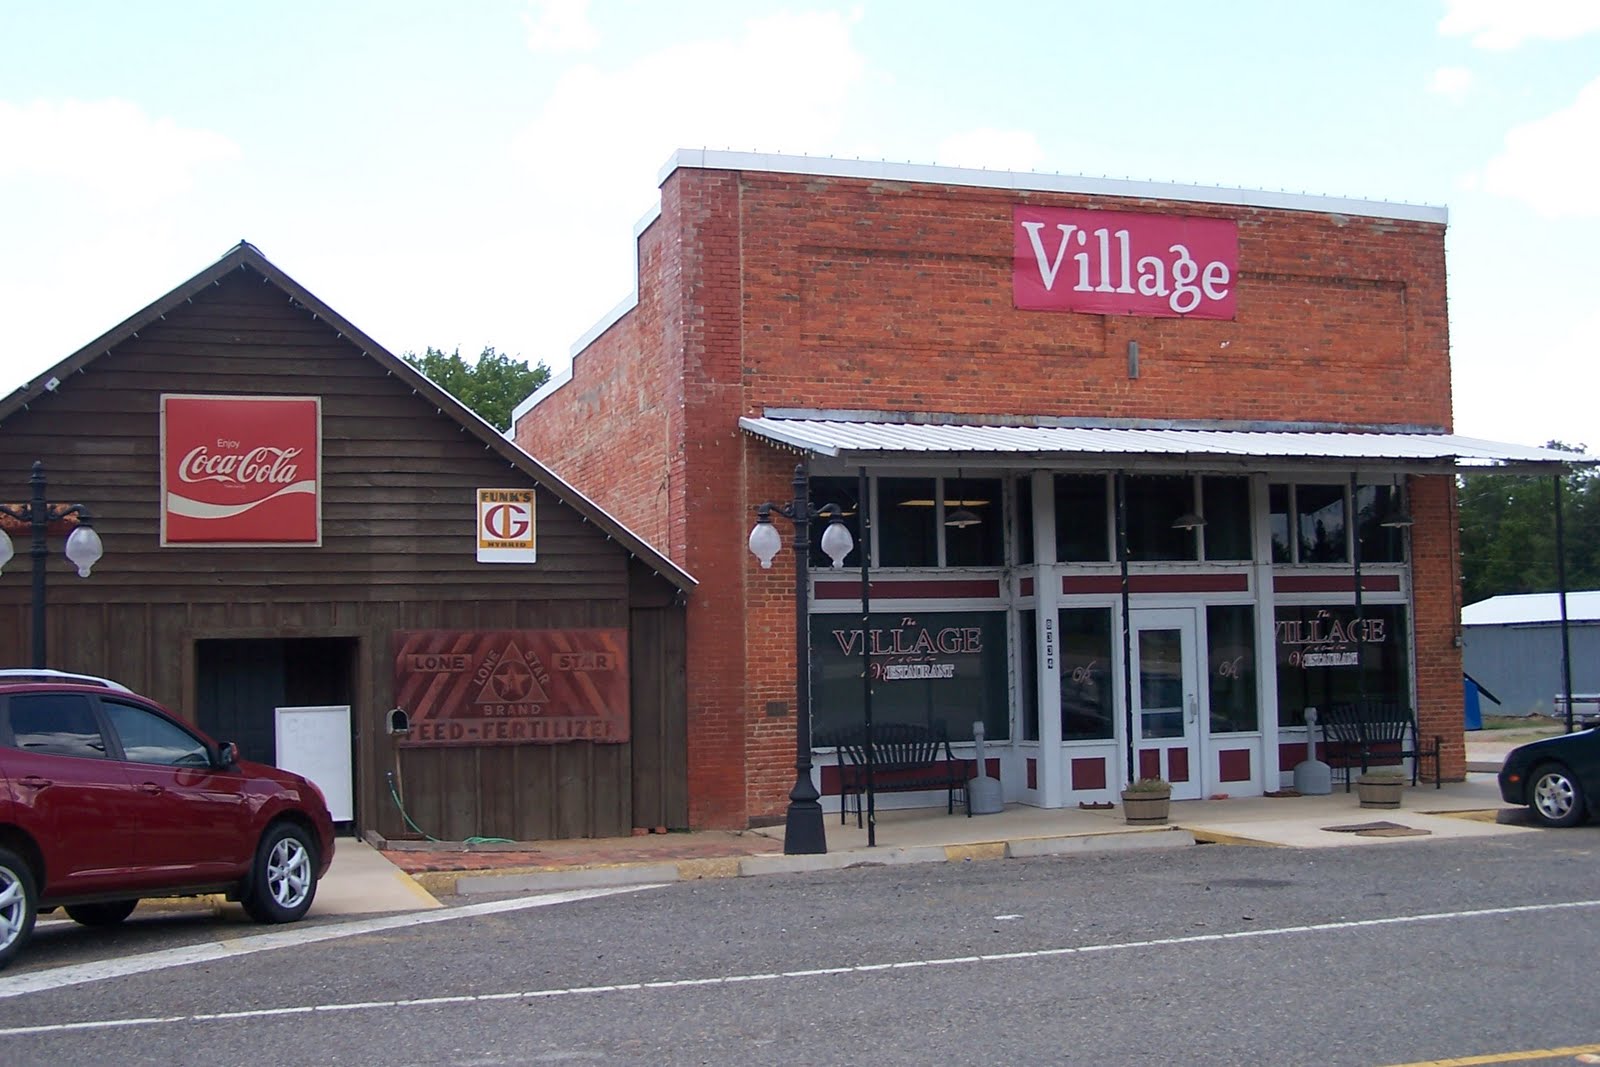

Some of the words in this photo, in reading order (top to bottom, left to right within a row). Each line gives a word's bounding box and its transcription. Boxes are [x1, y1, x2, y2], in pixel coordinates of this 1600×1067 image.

[1020, 220, 1230, 314] Village
[217, 438, 240, 449] Enjoy
[178, 446, 303, 484] Coca-Cola
[481, 492, 531, 502] FUNK'S
[901, 617, 917, 626] The
[414, 656, 465, 670] LONE
[559, 655, 608, 669] STAR
[473, 649, 500, 686] LONE
[524, 650, 551, 685] STAR
[484, 704, 541, 716] BRAND
